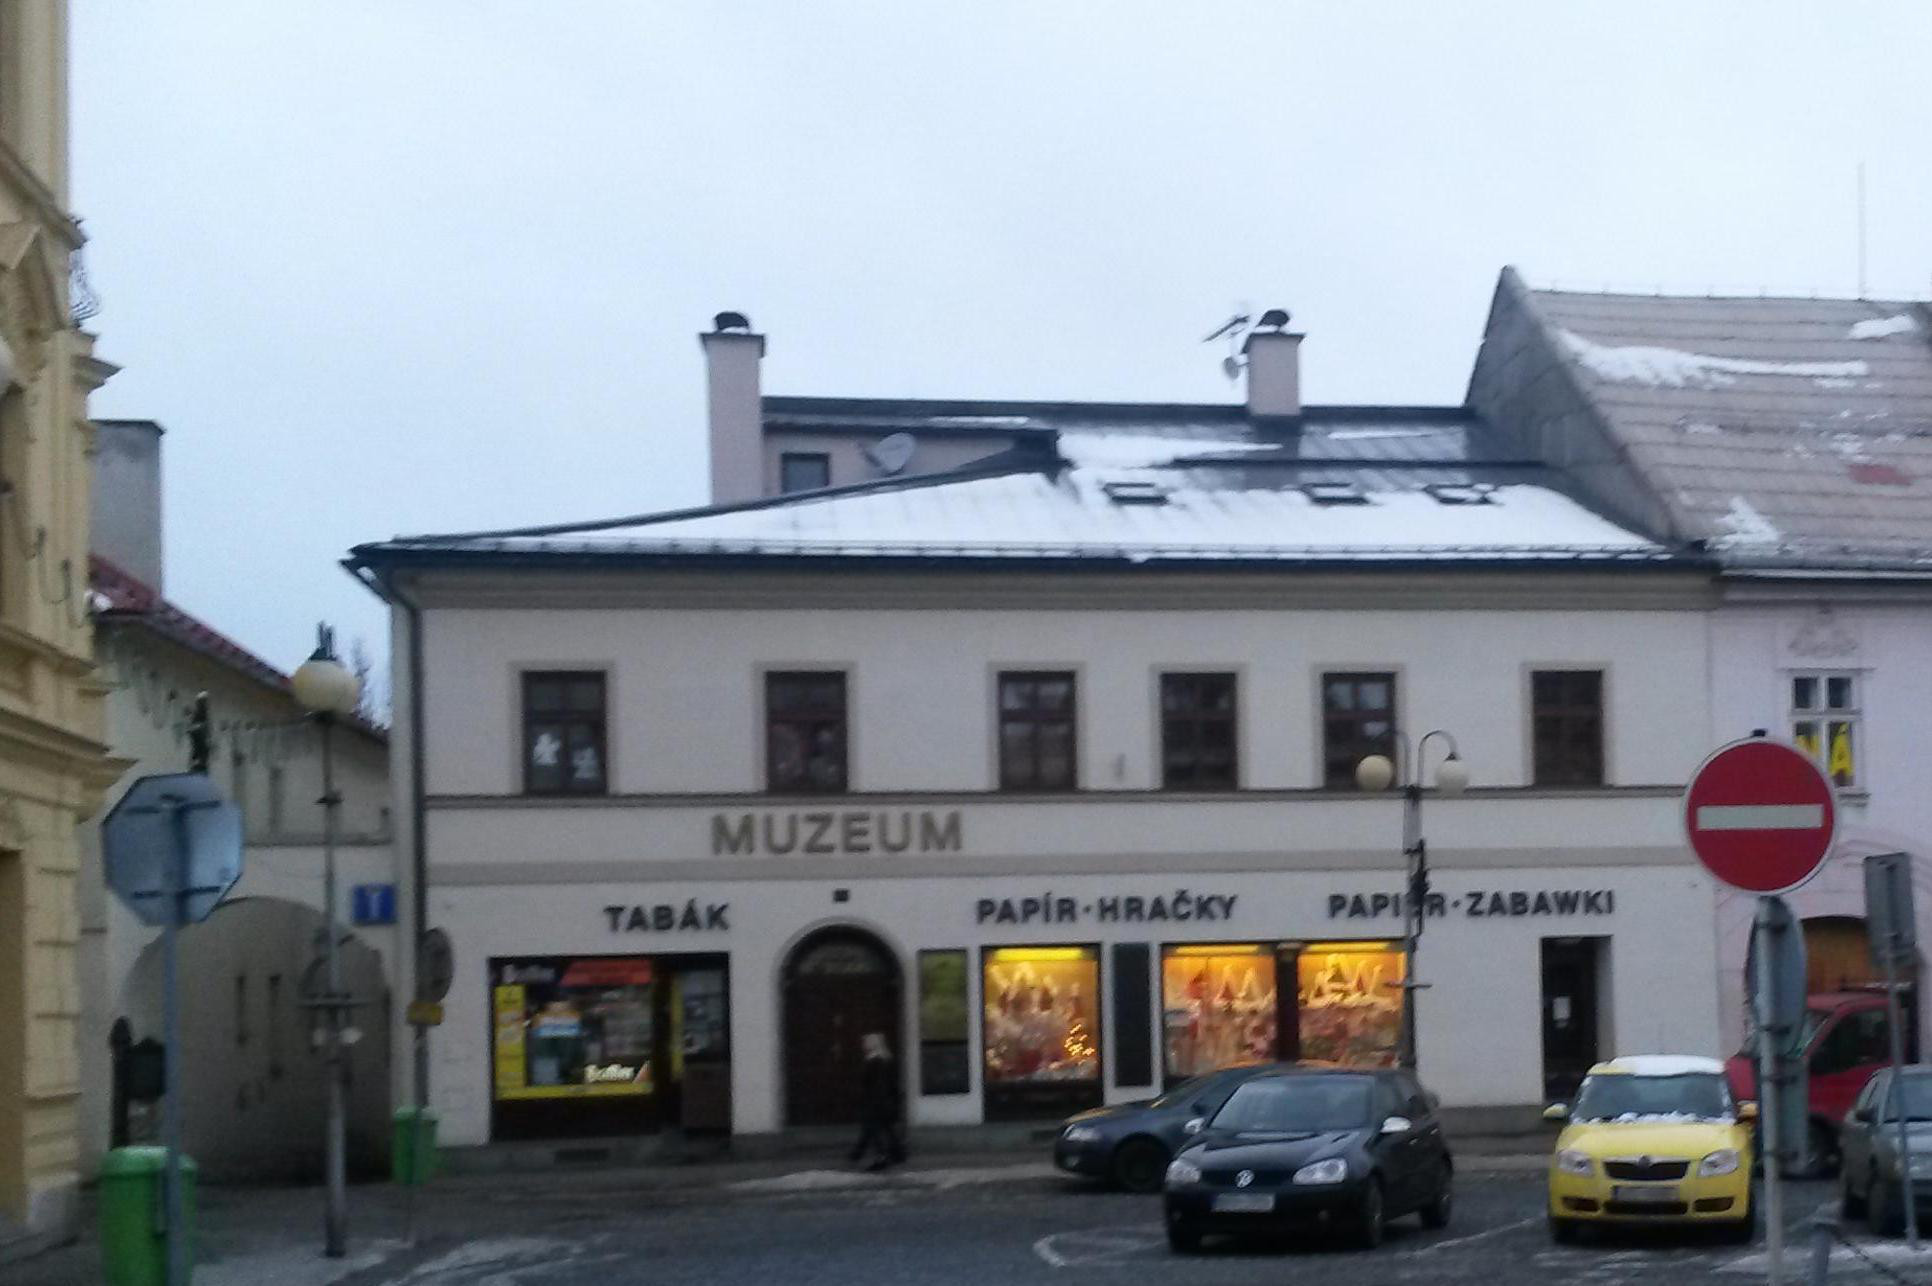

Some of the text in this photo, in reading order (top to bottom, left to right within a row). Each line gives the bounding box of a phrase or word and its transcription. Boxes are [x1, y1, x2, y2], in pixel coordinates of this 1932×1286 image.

[710, 811, 963, 856] MUZEUM
[603, 897, 730, 932] TABÁK
[1328, 892, 1446, 919] PAPIR
